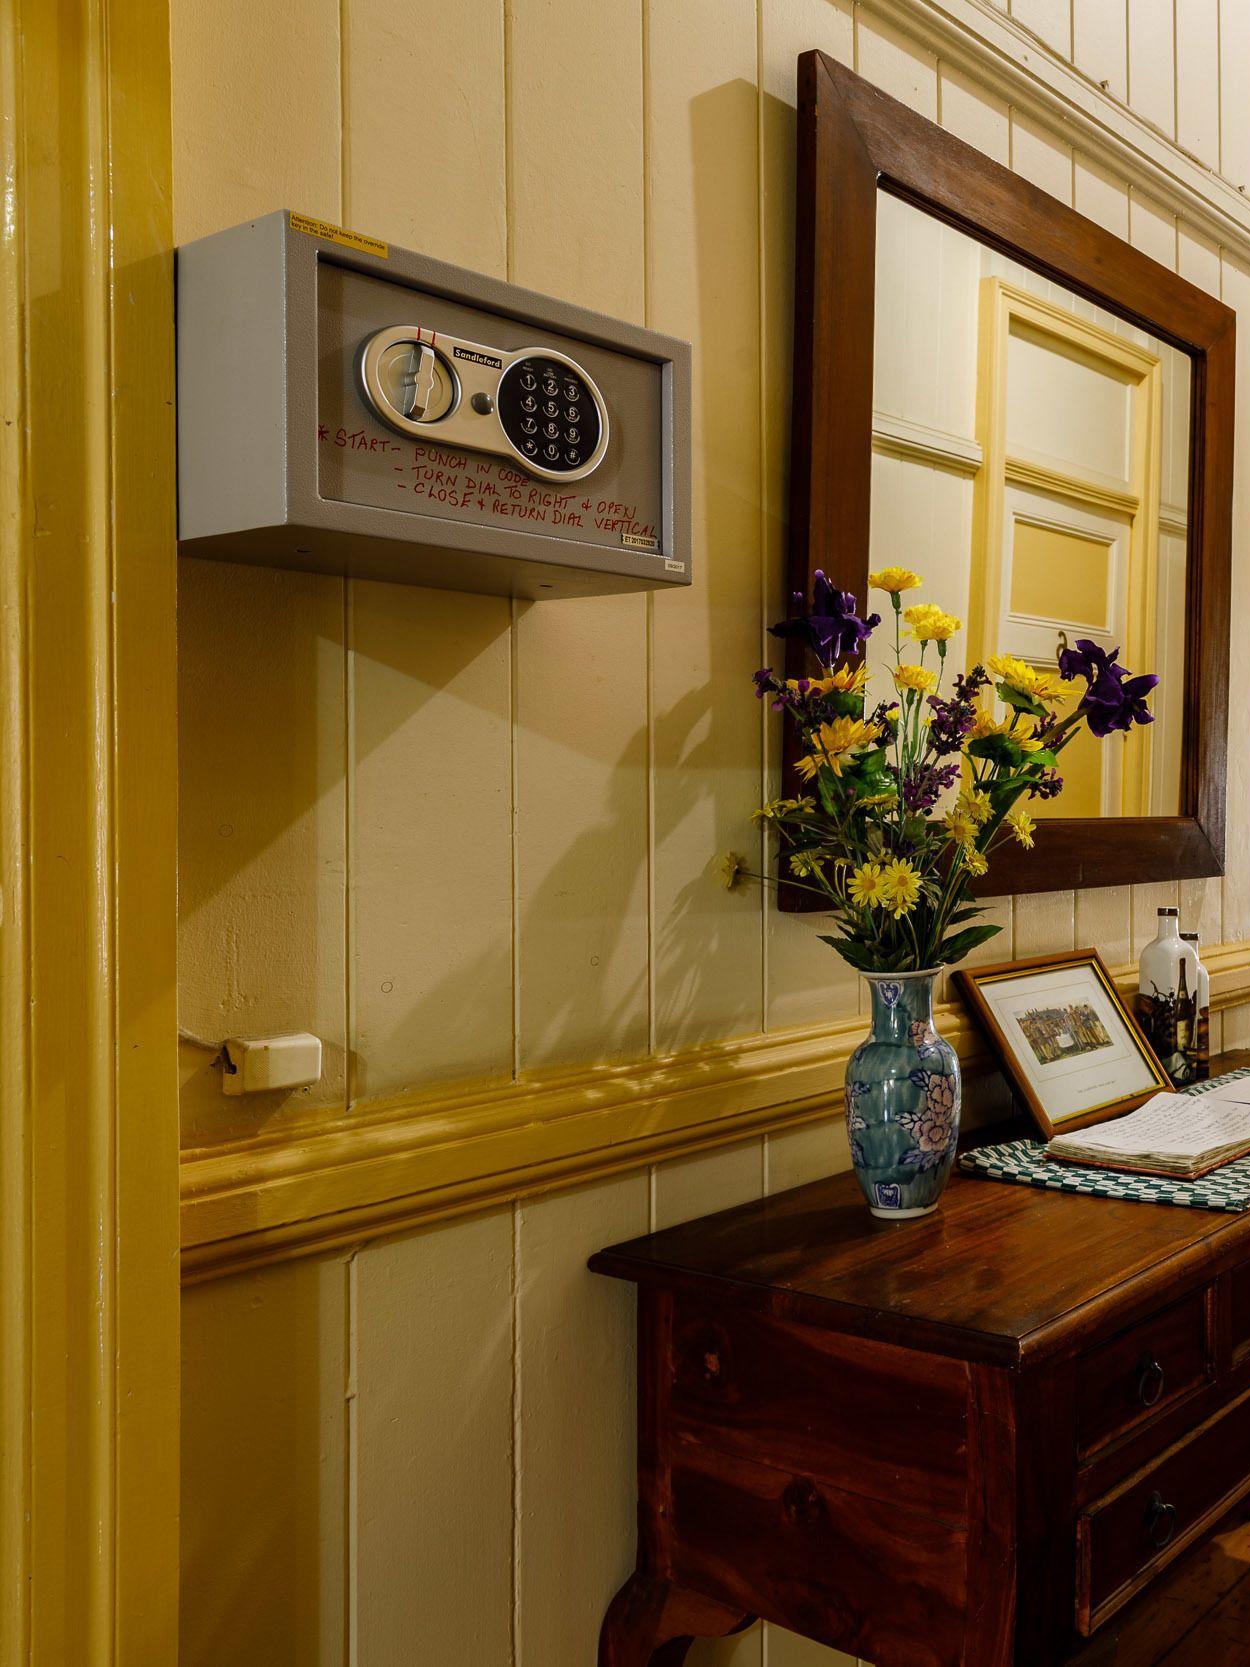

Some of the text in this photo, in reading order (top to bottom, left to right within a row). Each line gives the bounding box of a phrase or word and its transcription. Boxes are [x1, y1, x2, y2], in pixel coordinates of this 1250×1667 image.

[320, 224, 328, 232] Do
[329, 226, 338, 234] not
[455, 349, 500, 368] Sandleford
[548, 380, 554, 390] 2
[568, 386, 575, 396] 3
[526, 396, 576, 416] 4 5 6
[526, 418, 576, 438] 7 8 9
[549, 445, 554, 454] 0
[414, 447, 468, 471] PUNCH
[476, 462, 492, 474] IN
[498, 468, 530, 487] CODE
[412, 465, 458, 487] TURN
[464, 476, 502, 497] DIAL
[504, 485, 522, 500] TO
[528, 488, 577, 510] RIGHT
[596, 501, 637, 520] OPEN
[414, 482, 474, 508] CLOSE
[492, 500, 547, 521] RETURN
[552, 510, 584, 528] DIAL
[594, 518, 657, 538] VERTICAL
